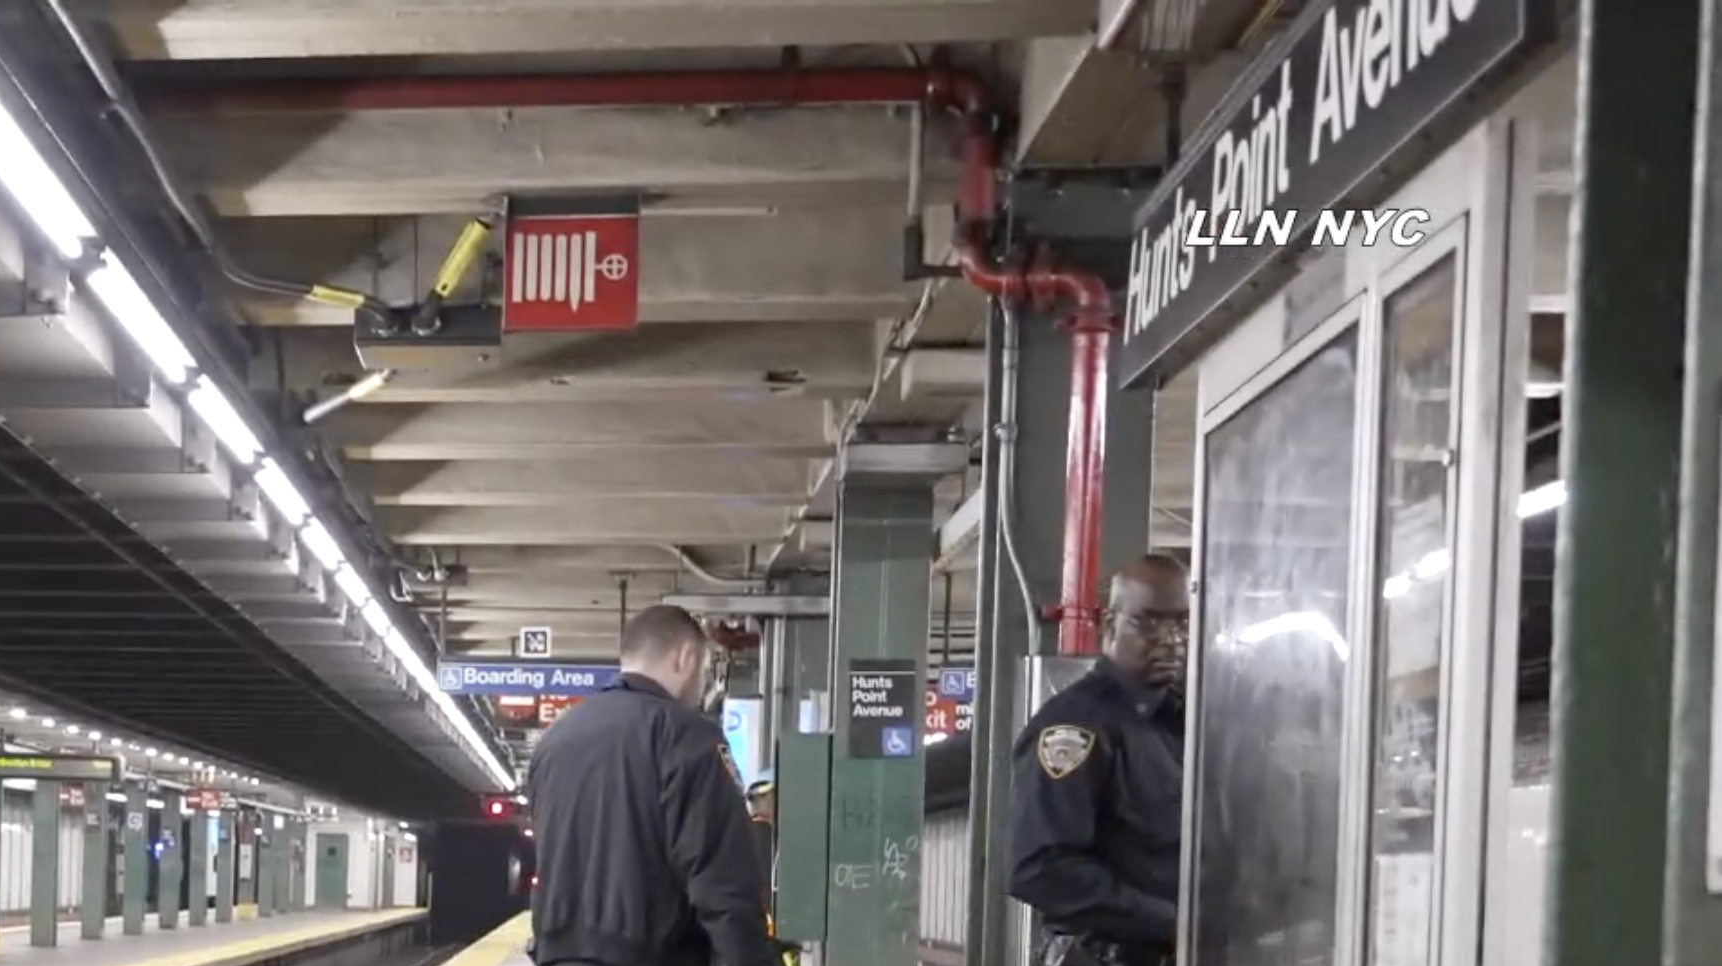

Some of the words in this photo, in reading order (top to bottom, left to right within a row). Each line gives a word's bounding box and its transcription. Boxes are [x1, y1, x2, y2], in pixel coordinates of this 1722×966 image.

[1123, 185, 1197, 346] Hunts
[1209, 58, 1293, 263] Point
[1309, 0, 1478, 165] Avenu
[464, 667, 546, 688] Boarding
[550, 669, 595, 686] Area
[852, 676, 894, 689] Hunts
[852, 689, 888, 703] Point
[852, 703, 904, 717] Avenue
